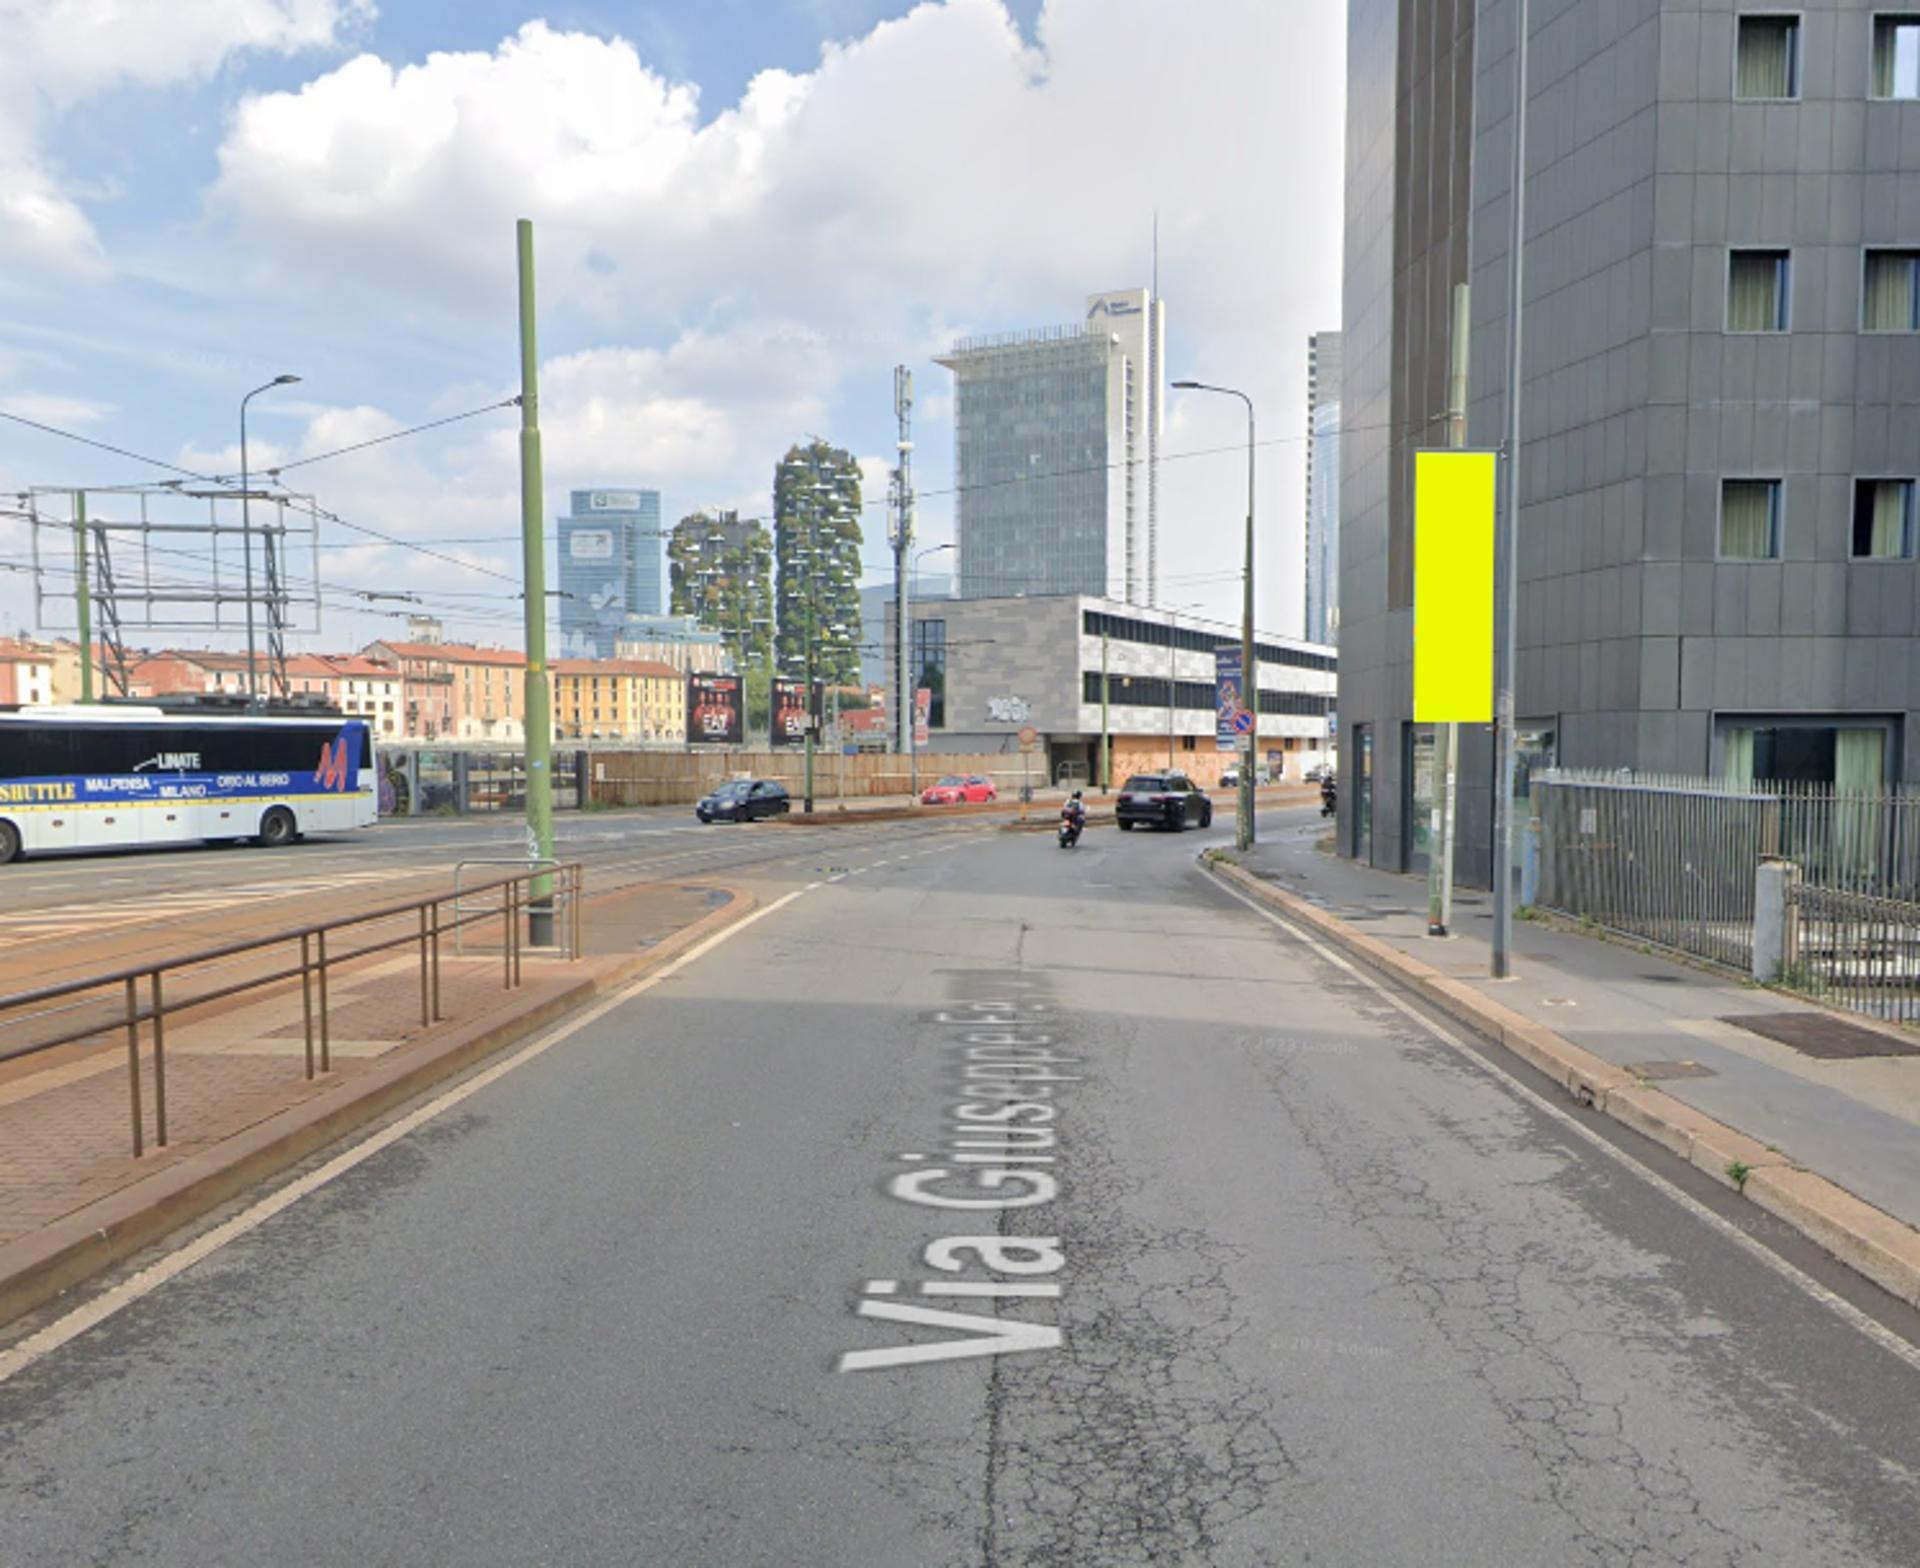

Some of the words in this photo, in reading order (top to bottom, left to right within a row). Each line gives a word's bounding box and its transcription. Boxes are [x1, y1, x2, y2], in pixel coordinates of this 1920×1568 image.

[0, 782, 76, 802] SHUTTLE
[85, 778, 152, 792] MALPENSA
[160, 784, 206, 797] MILANO
